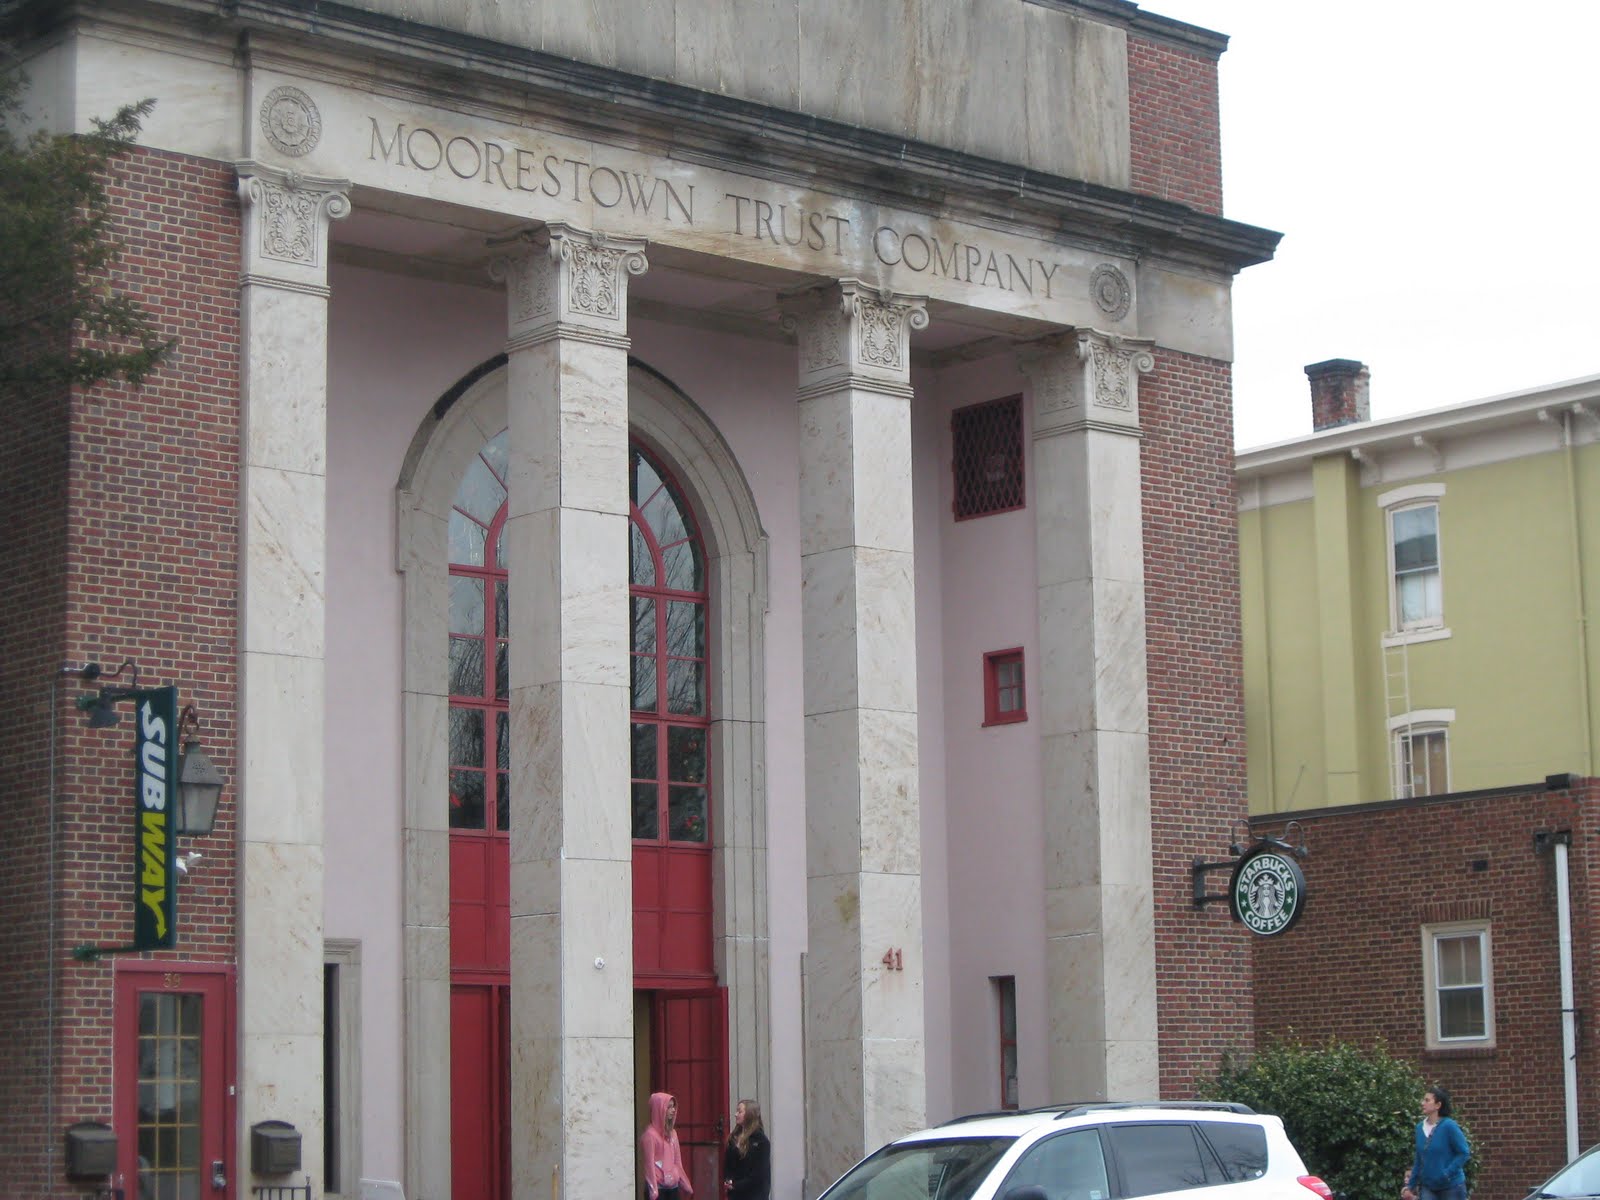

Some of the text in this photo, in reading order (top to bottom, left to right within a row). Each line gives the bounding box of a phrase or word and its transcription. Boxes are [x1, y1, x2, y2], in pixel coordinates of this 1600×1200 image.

[368, 116, 1060, 299] MOORESTOWN TRUST COMPANY
[140, 700, 167, 940] SUBWAY
[1239, 857, 1294, 894] STARBUCKS
[1245, 910, 1289, 931] COFFEE
[882, 947, 903, 971] 41
